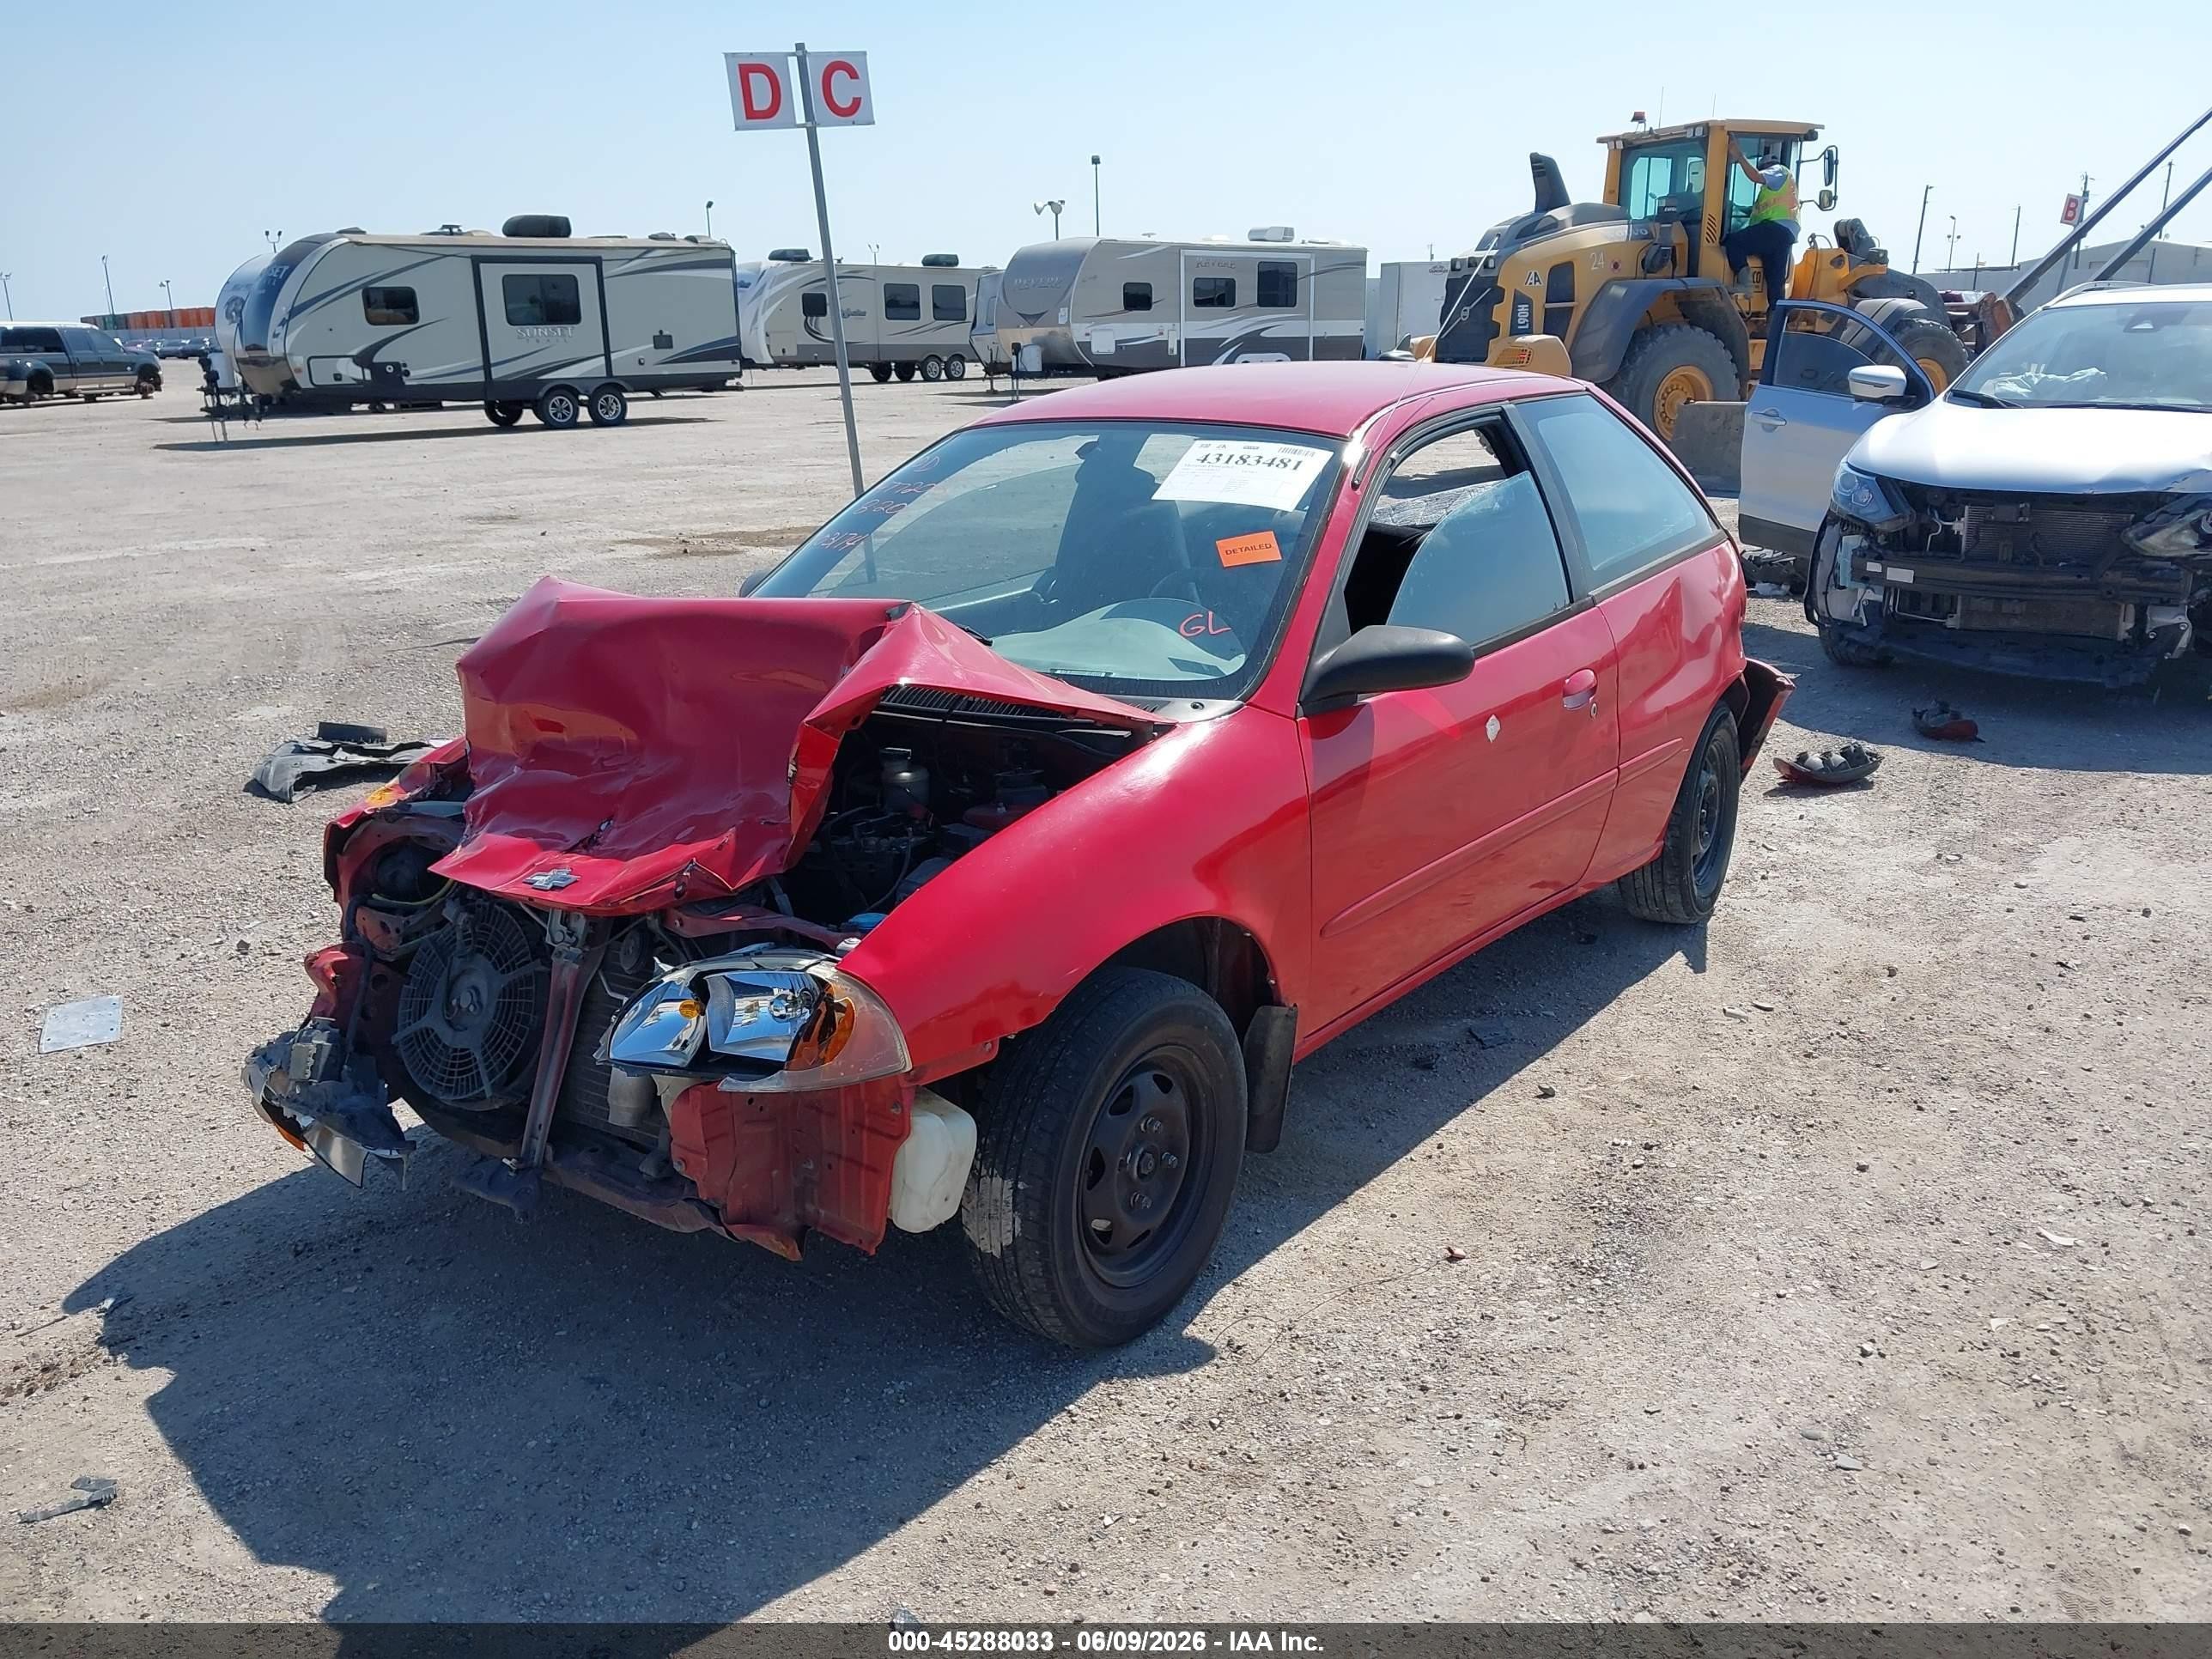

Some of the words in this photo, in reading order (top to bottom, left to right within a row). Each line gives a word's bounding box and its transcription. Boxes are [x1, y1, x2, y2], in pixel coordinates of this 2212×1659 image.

[738, 63, 781, 120] D
[822, 60, 862, 118] C
[2063, 198, 2079, 222] B
[1589, 252, 1605, 270] 24
[1518, 304, 1529, 330] L90H
[516, 326, 575, 338] SUNSET
[1196, 453, 1304, 471] 43183481
[1224, 543, 1273, 556] DETAILED
[1179, 611, 1232, 638] GL
